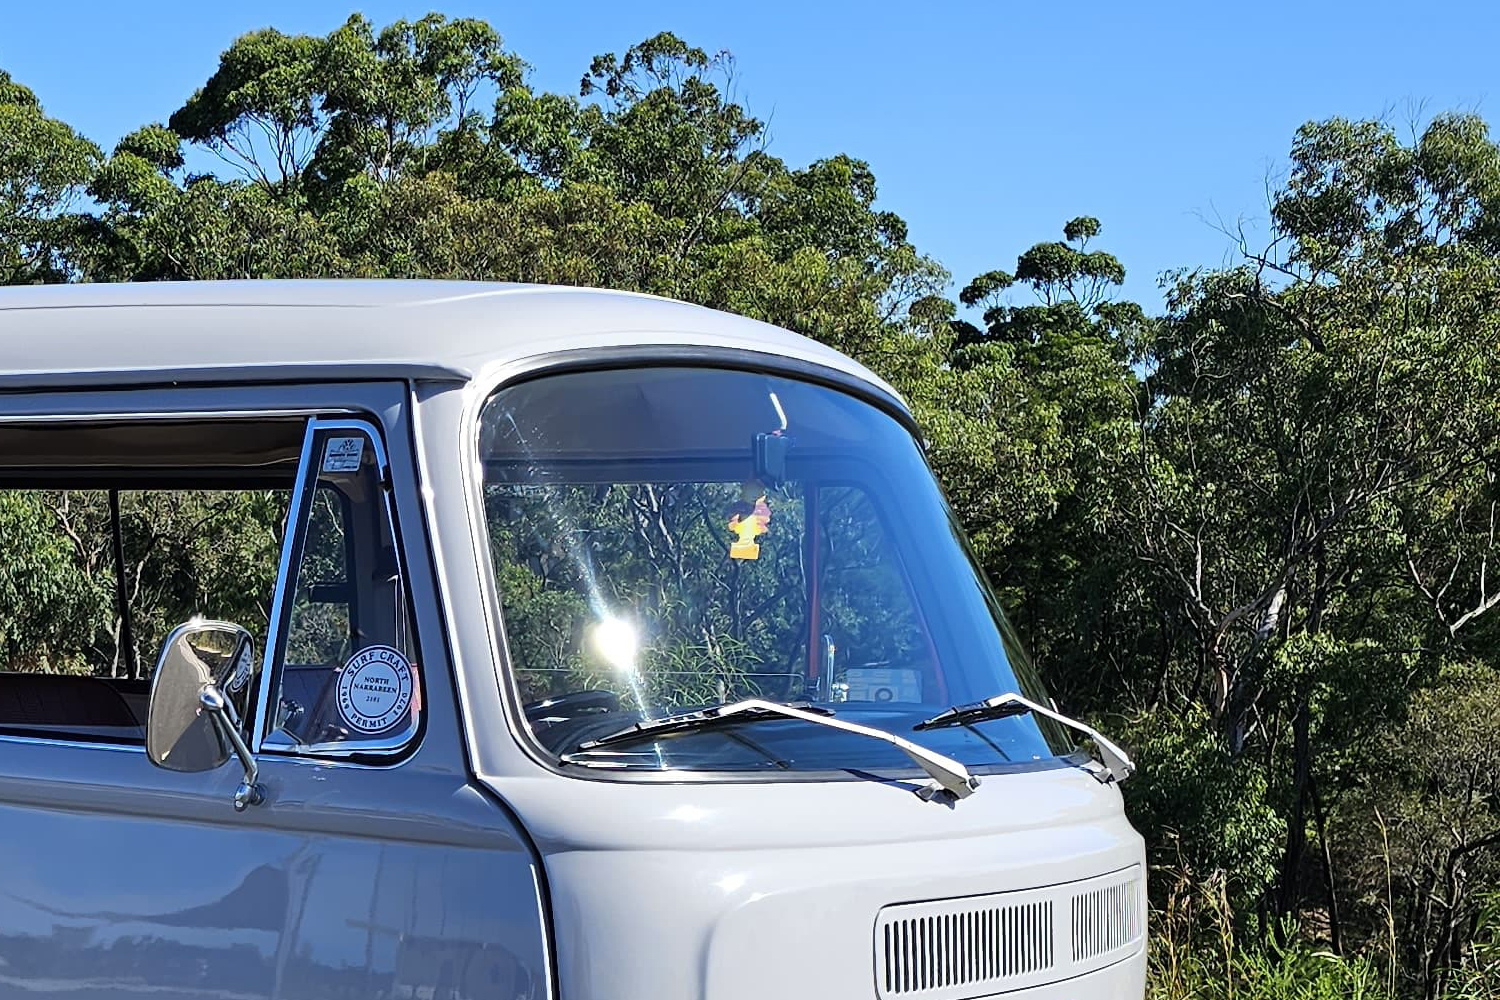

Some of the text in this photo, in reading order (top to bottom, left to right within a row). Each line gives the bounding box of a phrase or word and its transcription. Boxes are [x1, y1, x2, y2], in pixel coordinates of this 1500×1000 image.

[347, 651, 409, 681] SURF CRAFT
[364, 676, 389, 685] NORTH
[392, 692, 408, 716] 1970
[350, 713, 388, 728] PERMIT
